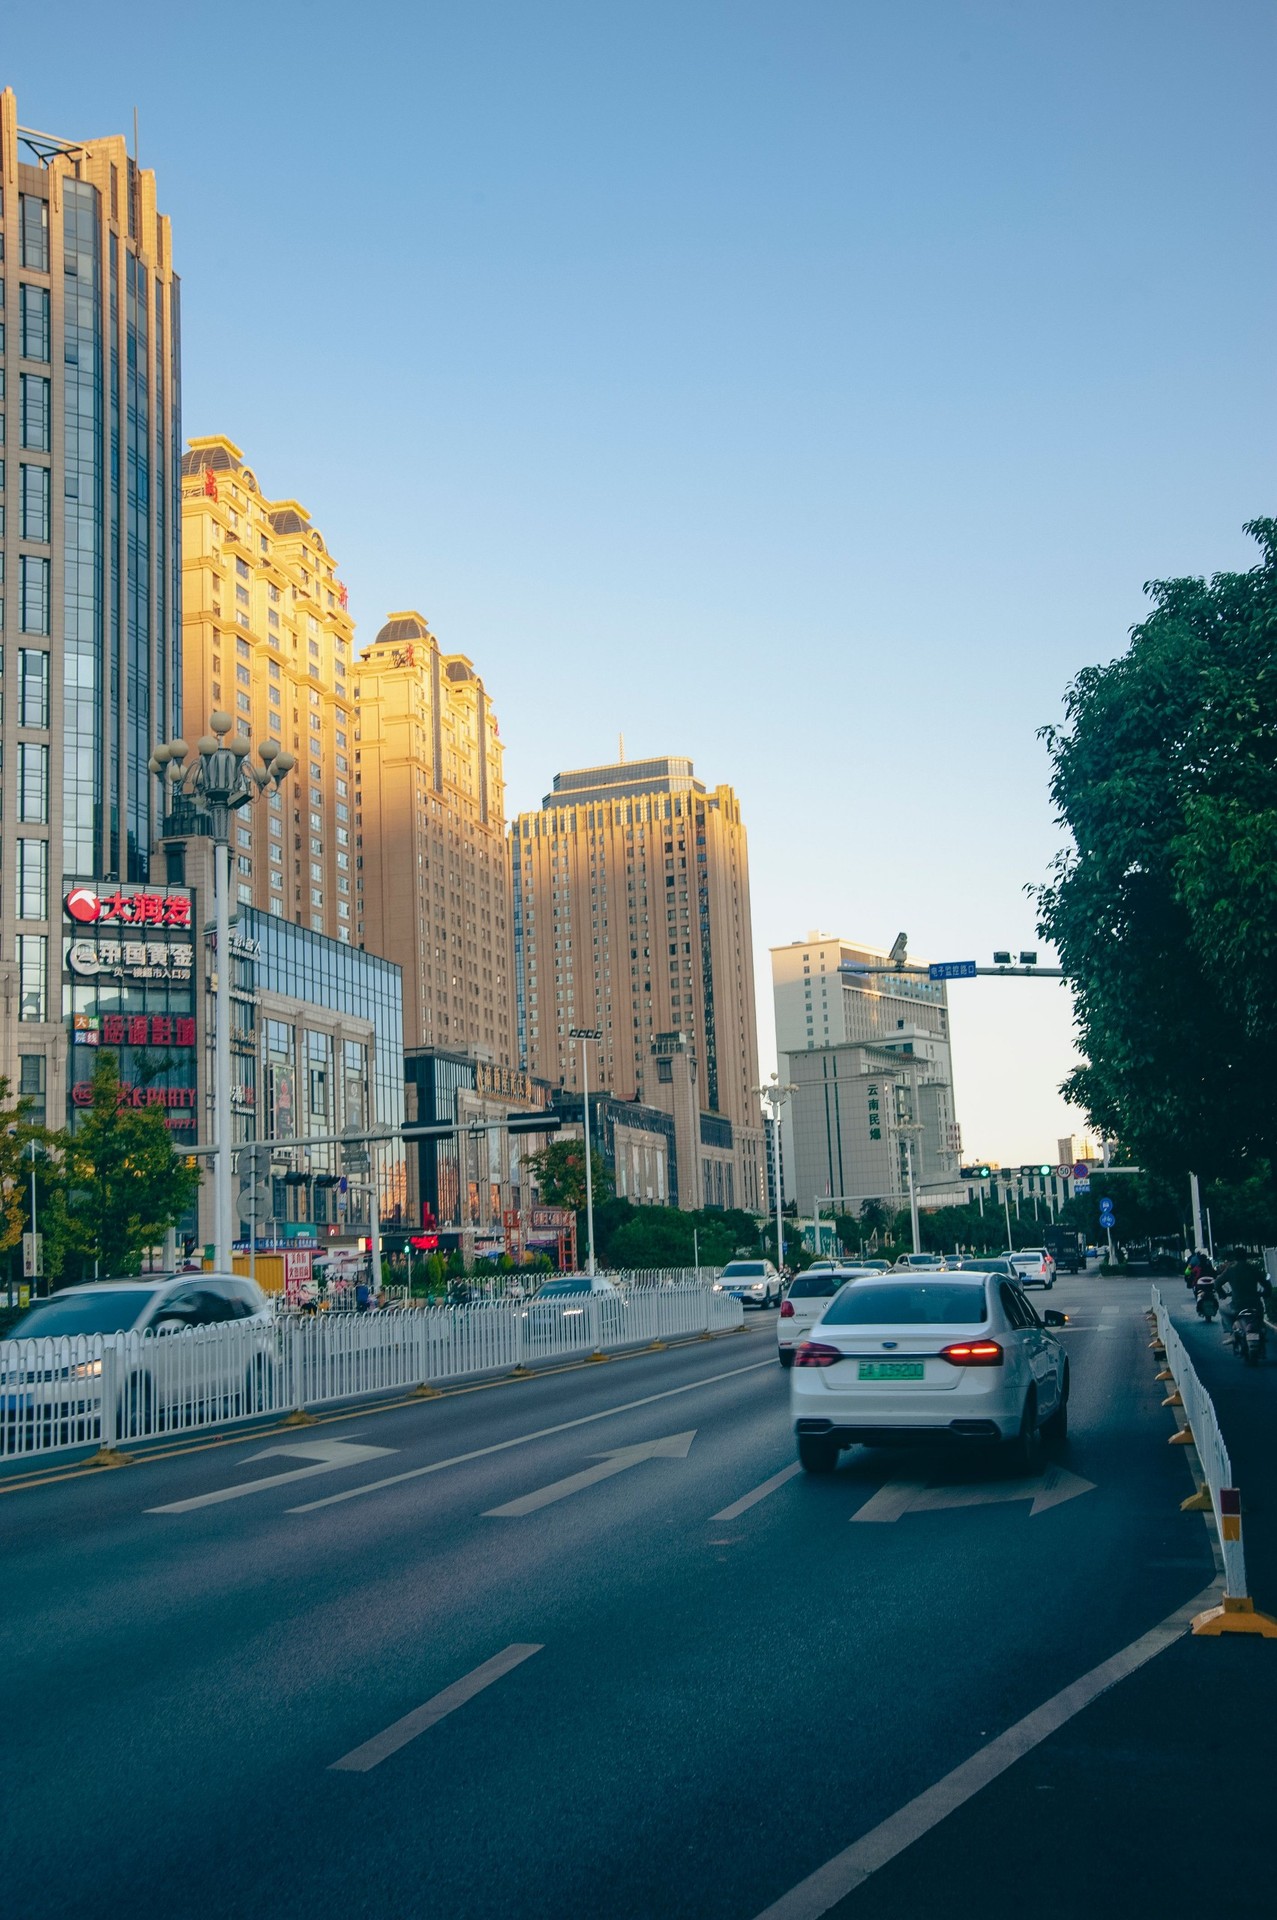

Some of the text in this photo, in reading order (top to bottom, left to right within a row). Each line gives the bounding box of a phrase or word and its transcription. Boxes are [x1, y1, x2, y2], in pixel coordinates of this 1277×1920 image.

[102, 891, 192, 924] 大润发
[99, 942, 193, 967] 中国黄金
[930, 964, 975, 977] 电子监控路口
[867, 1084, 882, 1141] 云南民爆
[1060, 1167, 1069, 1175] 50
